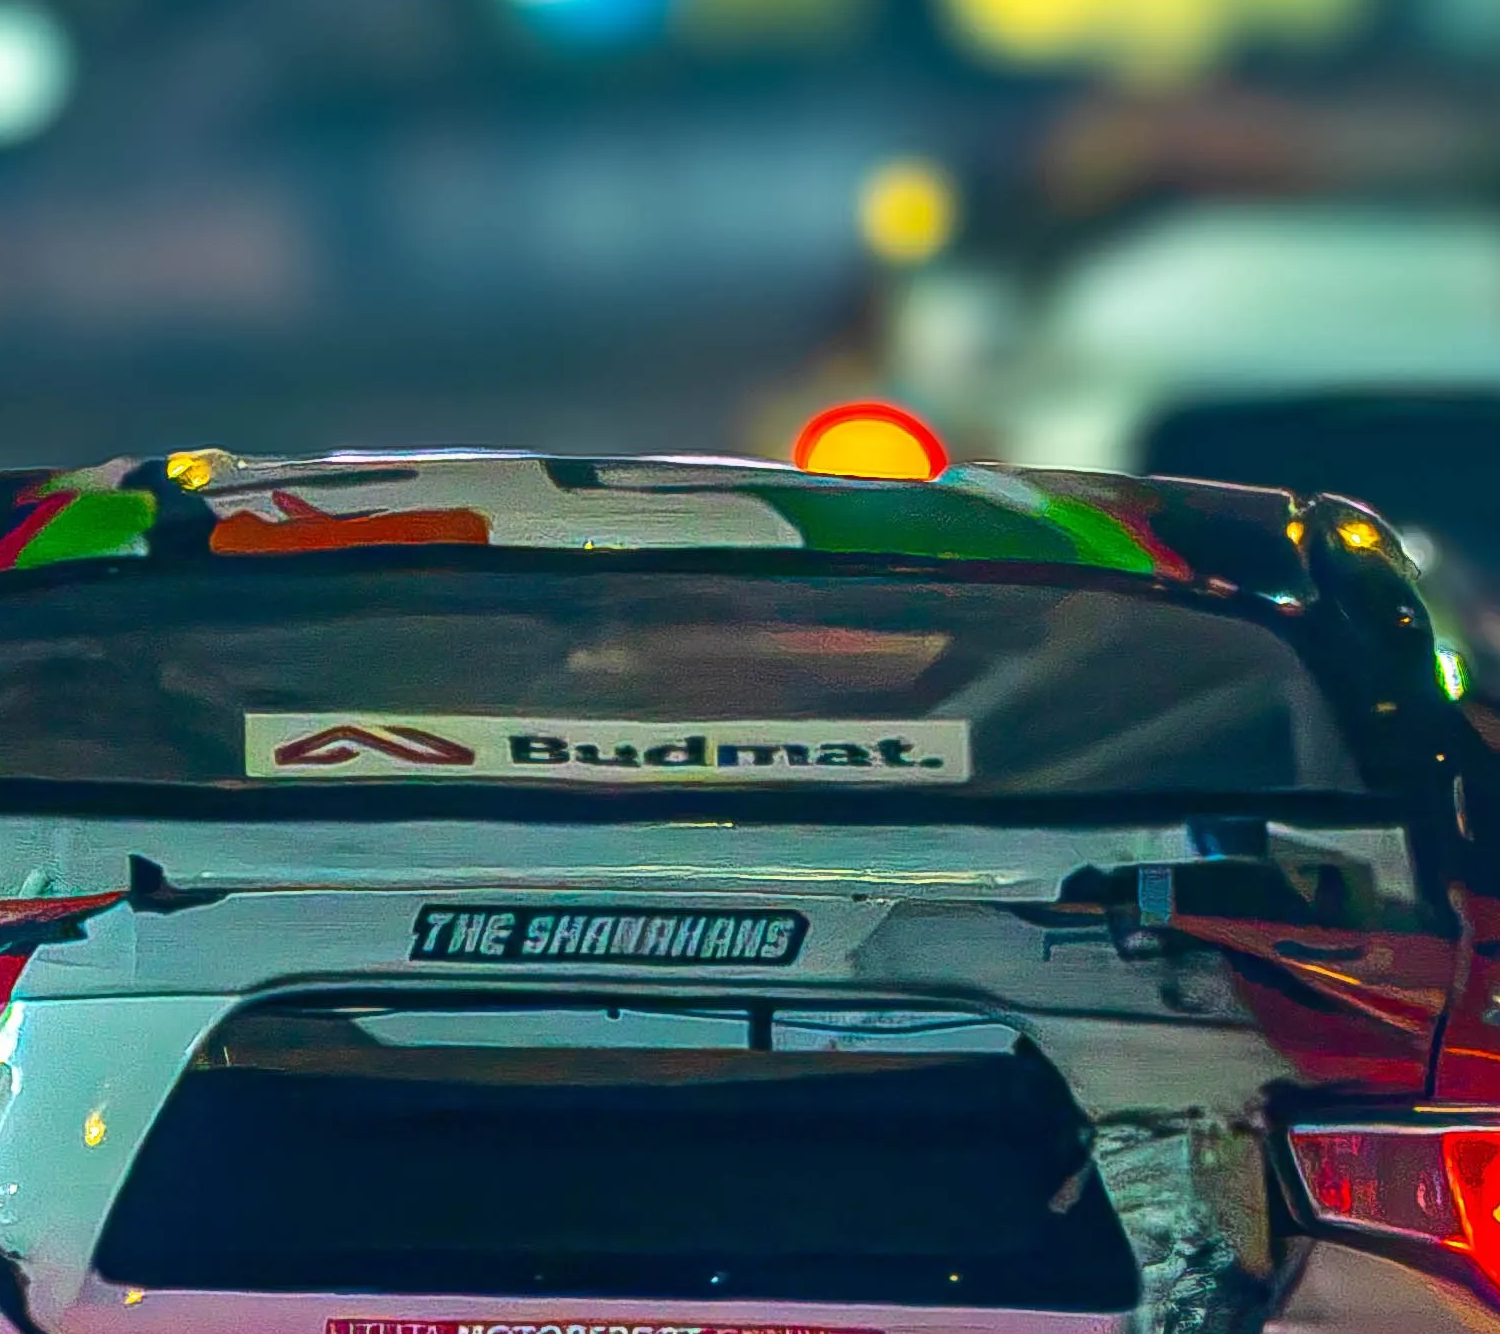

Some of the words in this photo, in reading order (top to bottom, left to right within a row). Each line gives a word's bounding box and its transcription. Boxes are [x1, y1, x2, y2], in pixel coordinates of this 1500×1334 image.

[507, 733, 946, 770] Budmat.
[422, 911, 516, 956] THE
[521, 913, 797, 959] SHANAHANS
